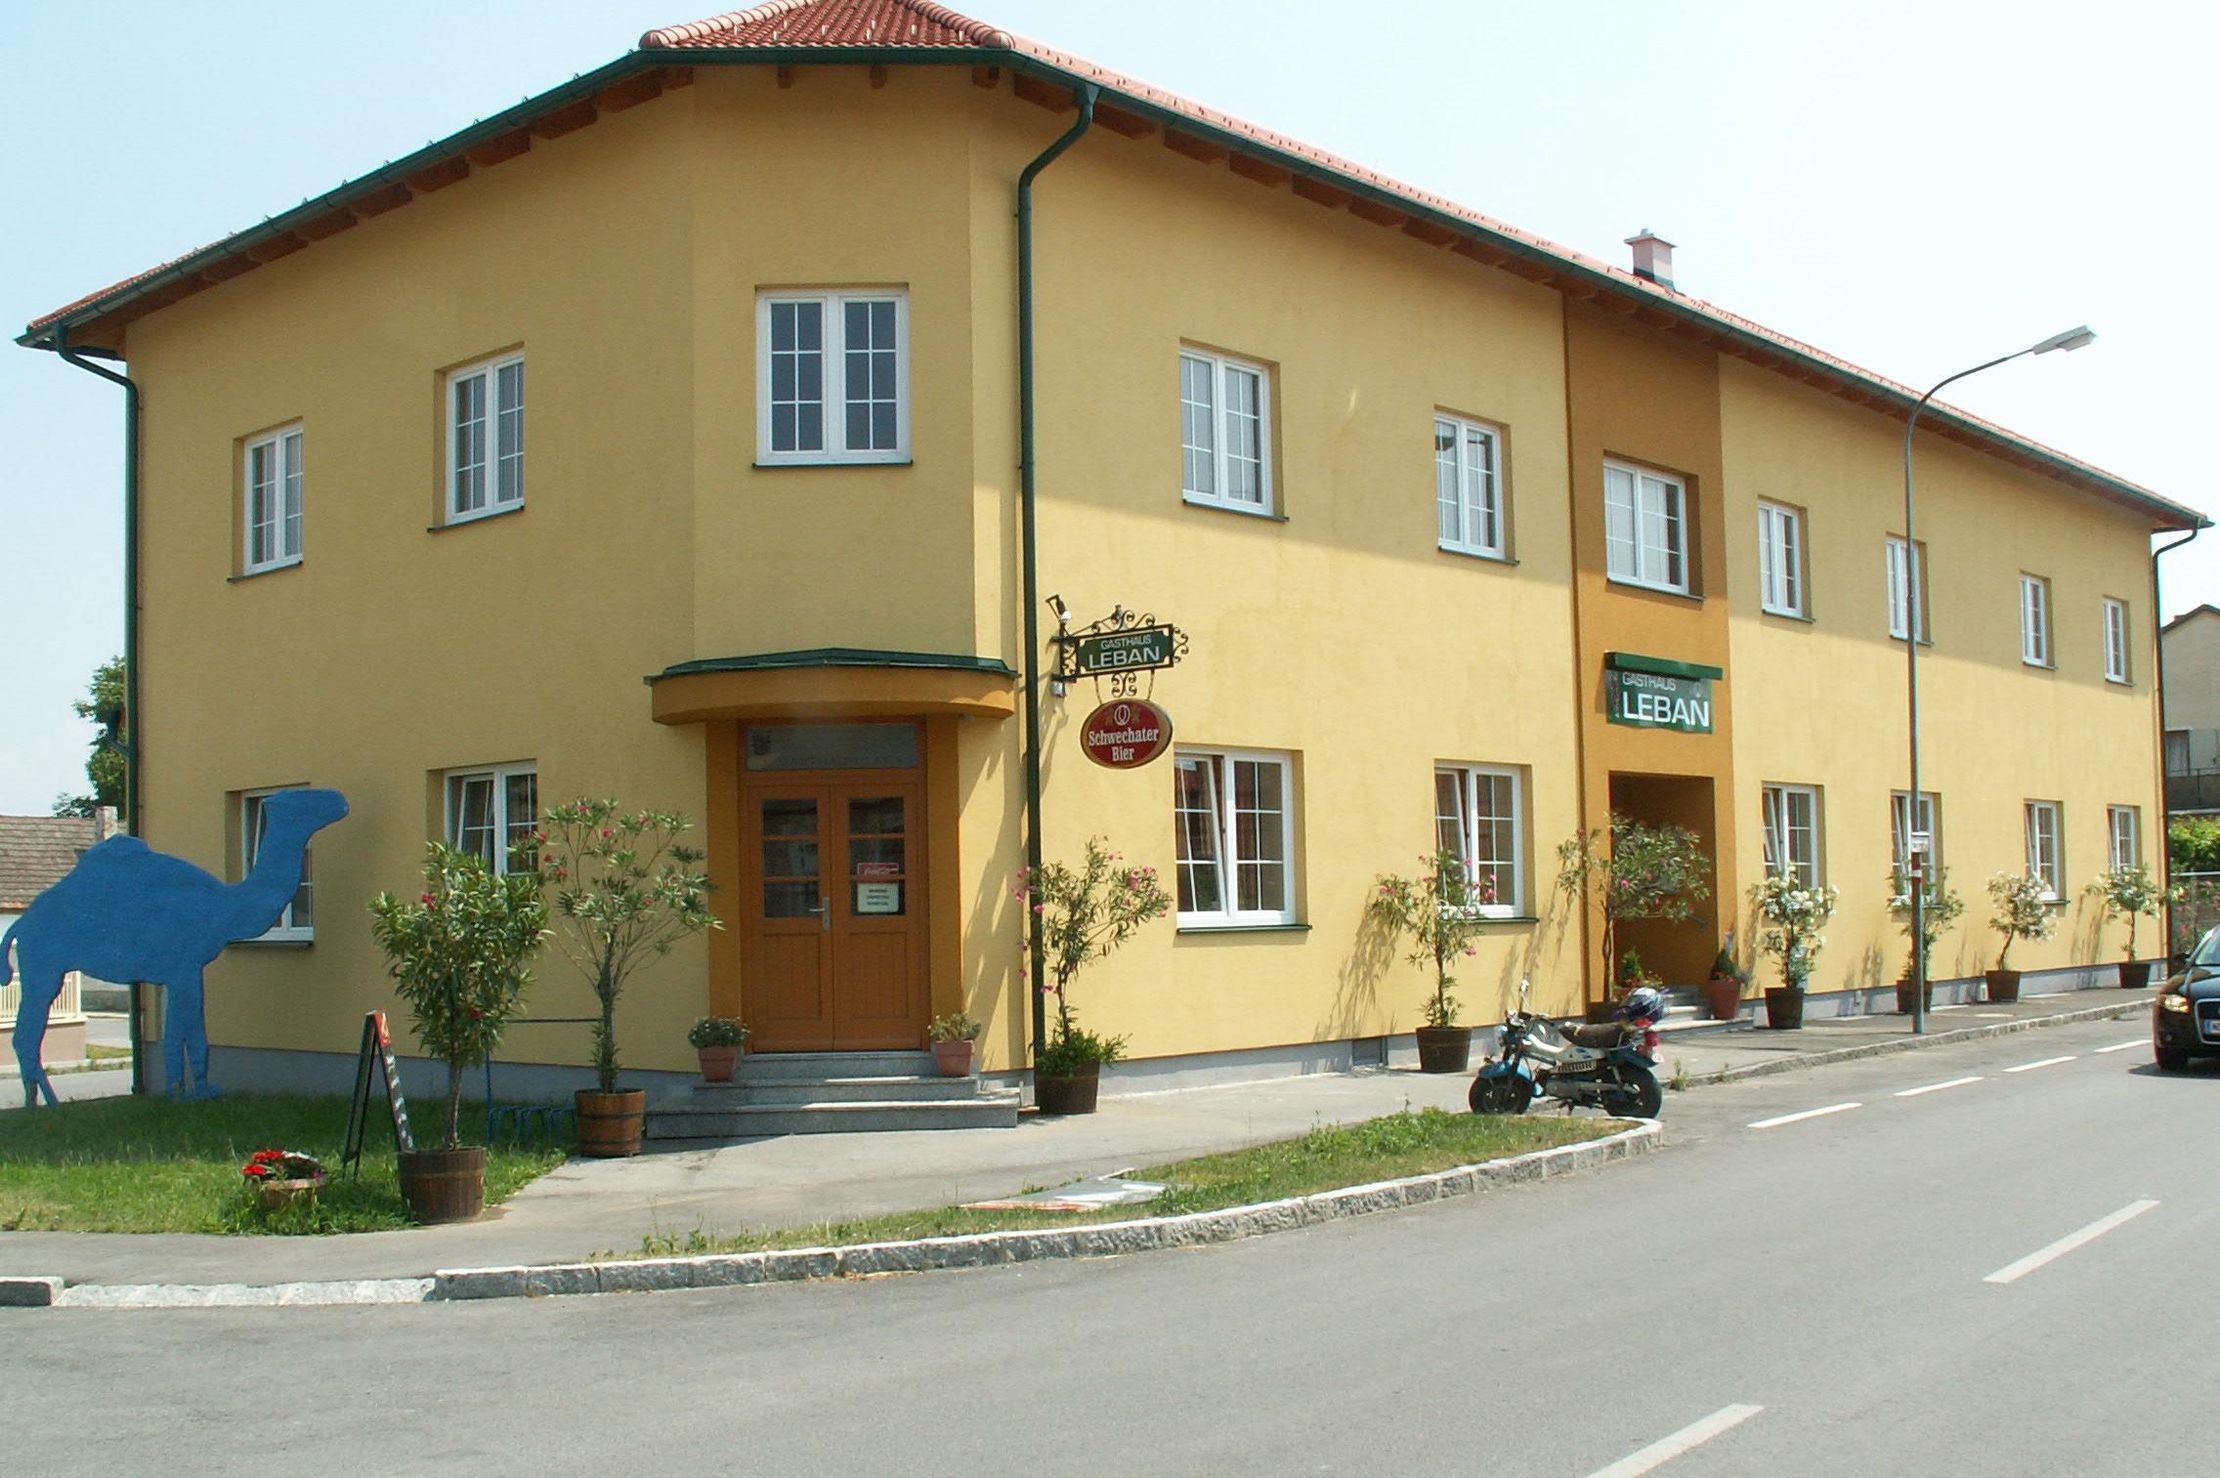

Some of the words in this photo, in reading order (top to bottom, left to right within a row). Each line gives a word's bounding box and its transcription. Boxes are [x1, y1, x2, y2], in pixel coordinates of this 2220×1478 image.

[1101, 634, 1151, 650] GASTHAUS
[1088, 645, 1160, 669] LEBAN
[1622, 671, 1676, 691] GASTHAUS
[1622, 691, 1710, 727] LEBAN
[1088, 728, 1159, 746] Schwechater
[1112, 746, 1134, 762] Bier
